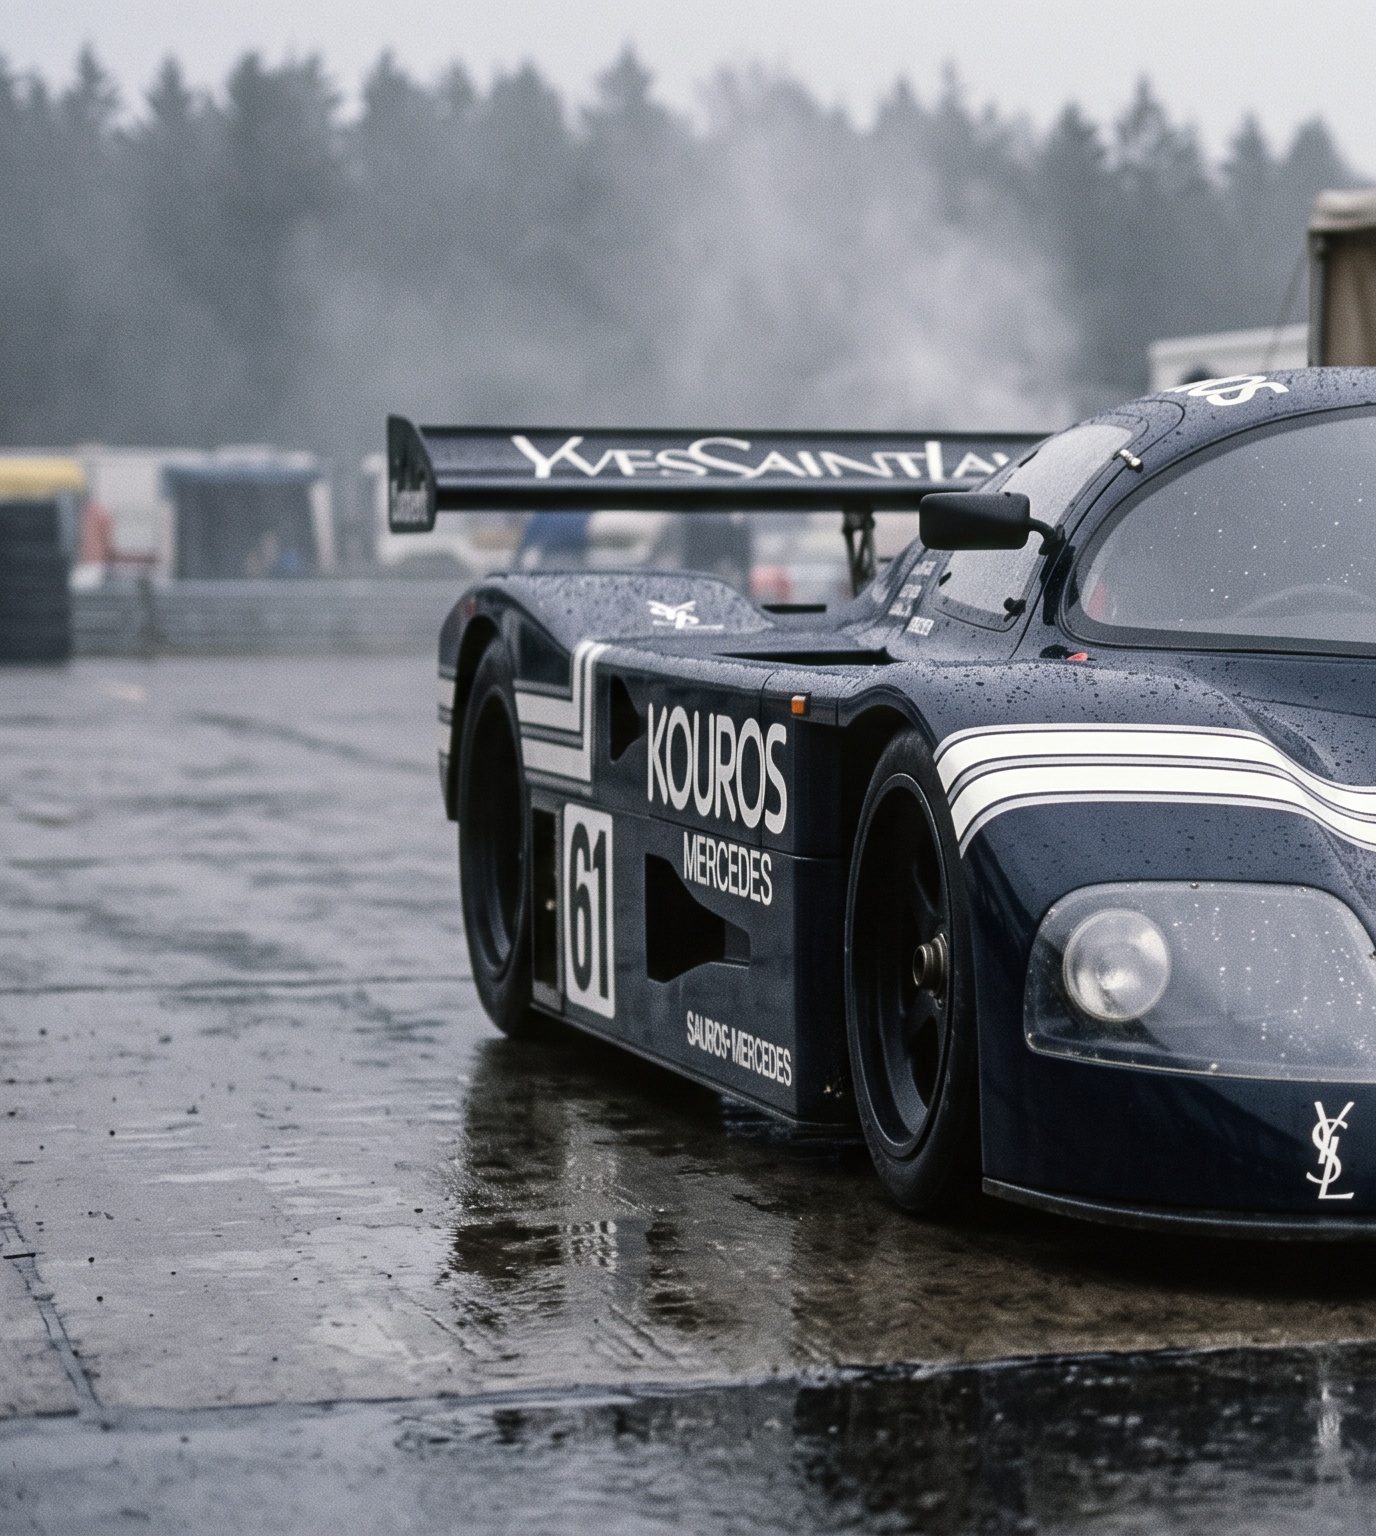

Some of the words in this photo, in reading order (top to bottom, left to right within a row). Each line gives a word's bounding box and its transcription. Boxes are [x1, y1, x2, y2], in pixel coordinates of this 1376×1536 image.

[648, 702, 787, 834] KOUROS
[569, 822, 610, 1001] 61
[684, 831, 773, 906] MERCEDES
[1306, 1101, 1355, 1199] YSL
